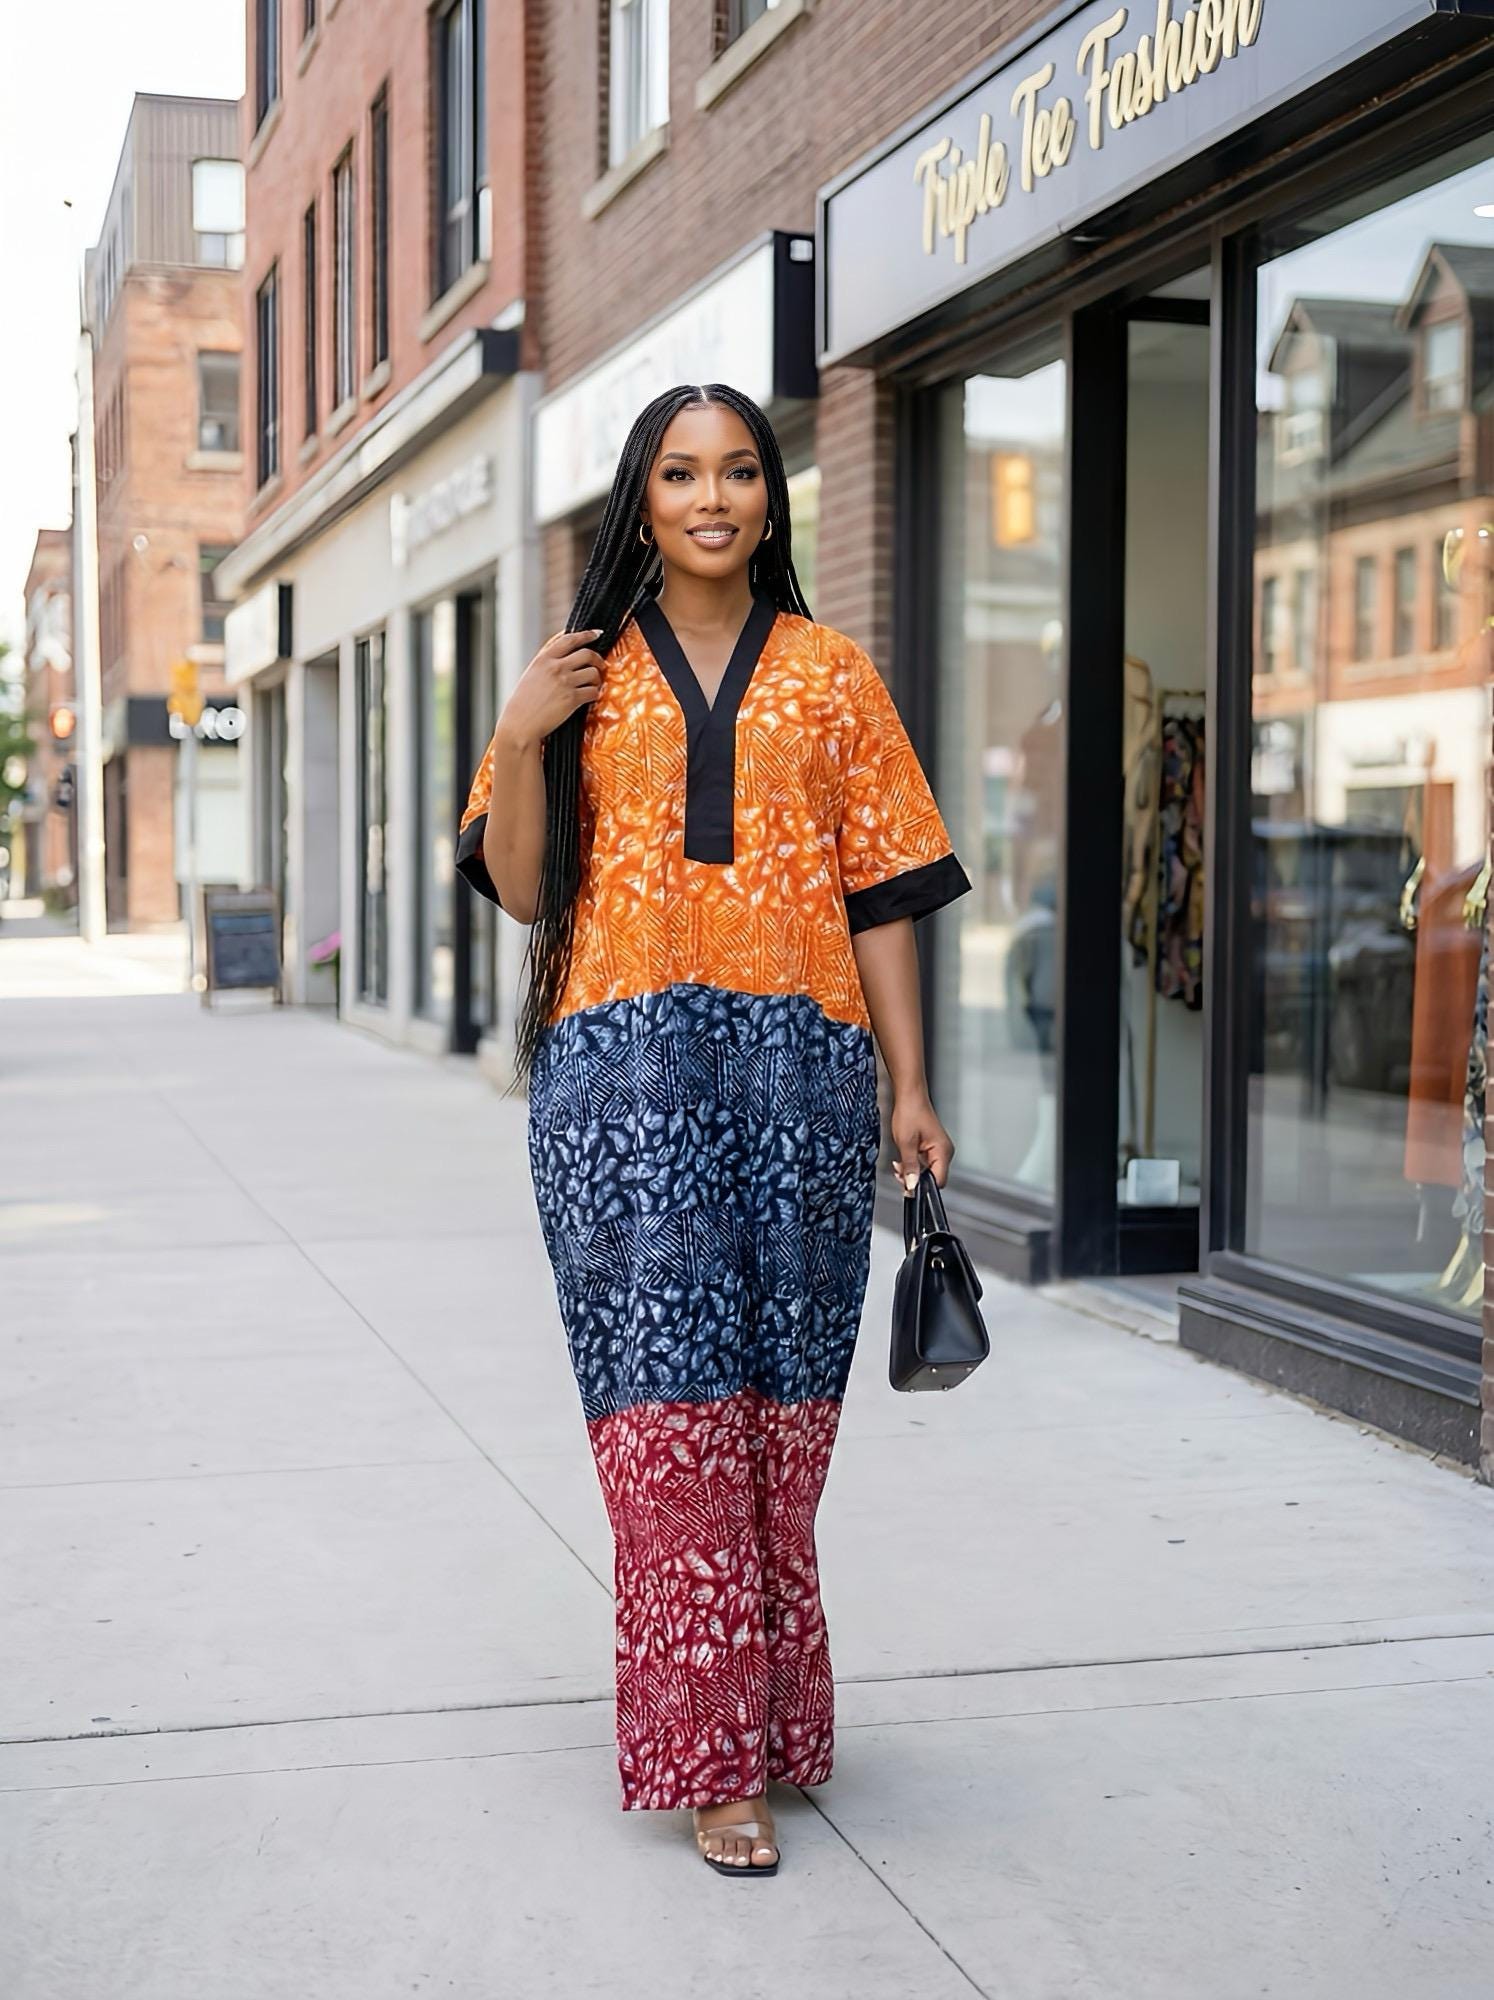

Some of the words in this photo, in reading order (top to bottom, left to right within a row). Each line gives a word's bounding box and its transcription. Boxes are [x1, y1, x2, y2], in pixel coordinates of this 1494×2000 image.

[914, 113, 1011, 264] Triple
[1010, 63, 1077, 192] Tee
[1077, 0, 1264, 150] Fashion
